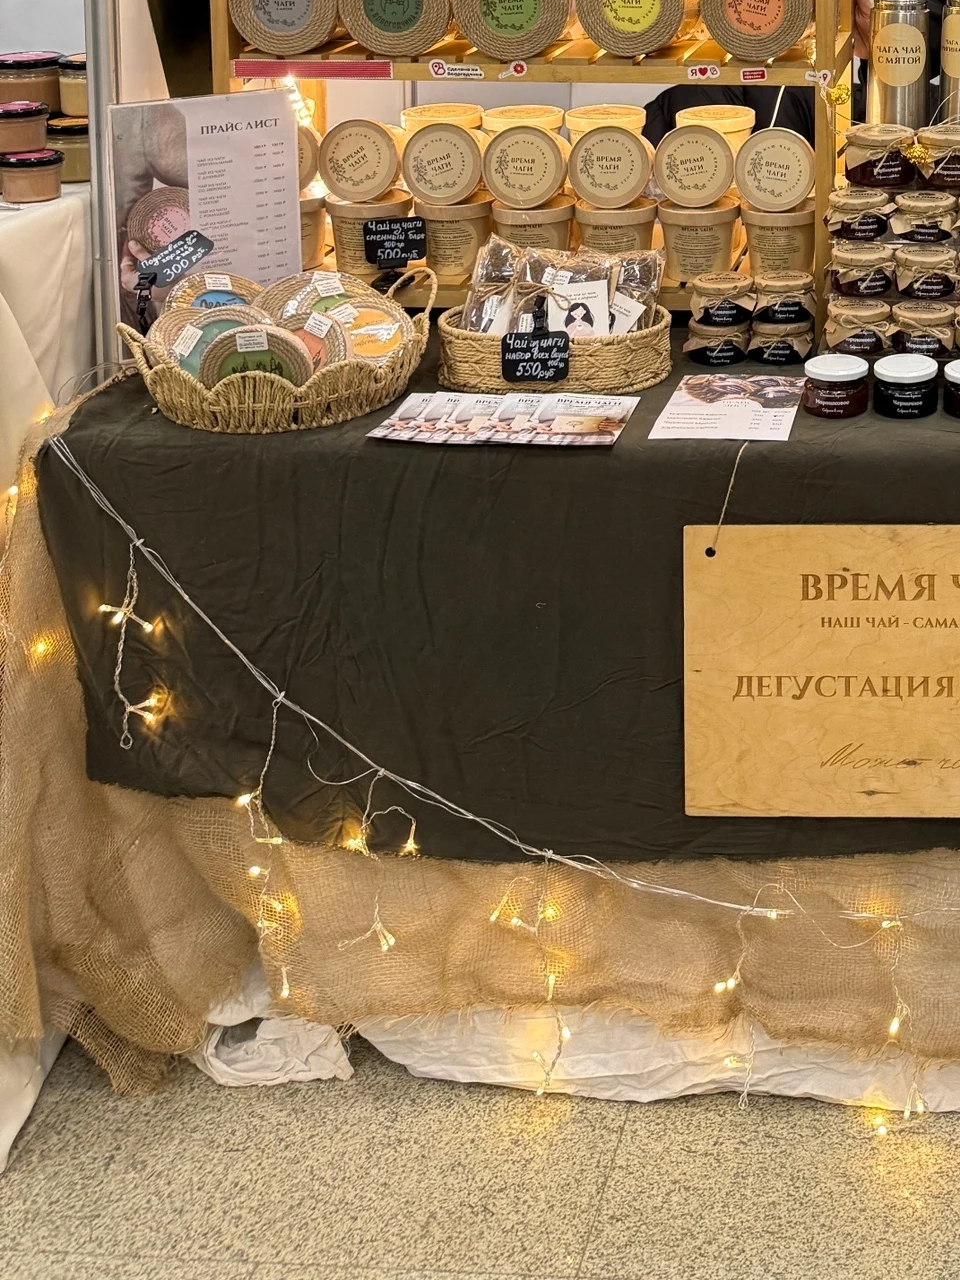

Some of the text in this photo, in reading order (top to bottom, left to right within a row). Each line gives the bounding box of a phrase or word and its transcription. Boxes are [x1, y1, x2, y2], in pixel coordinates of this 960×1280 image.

[501, 4, 523, 12] ЧАГИ
[747, 3, 767, 12] ЧАГИ
[372, 12, 416, 29] ВОЛОГОДЧИНА
[876, 45, 921, 54] ЧАГА ЧАЙ
[877, 54, 921, 65] С МЯТОЙ
[201, 118, 279, 135] ПРАЙС ЛИСТ
[342, 146, 365, 164] ВРЕМЯ
[427, 153, 451, 166] ВРЕМЯ
[348, 154, 367, 168] ЧАГИ
[680, 156, 705, 166] ВРЕМЯ
[764, 160, 790, 170] ВРЕМЯ
[431, 162, 452, 173] ЧАГИ
[683, 164, 704, 172] ЧАГИ
[766, 169, 786, 178] ЧАГИ
[368, 221, 389, 231] Чай
[366, 230, 425, 240] сменный блок
[377, 248, 401, 259] 500
[163, 259, 189, 281] 300
[507, 334, 528, 349] Чай
[516, 362, 541, 376] 550
[800, 572, 937, 603] ВРЕМЯ
[820, 616, 861, 629] НАШ
[865, 614, 900, 629] ЧАЙ
[912, 617, 959, 630] САМА
[732, 675, 955, 702] ДЕГУСТАЦИЯ
